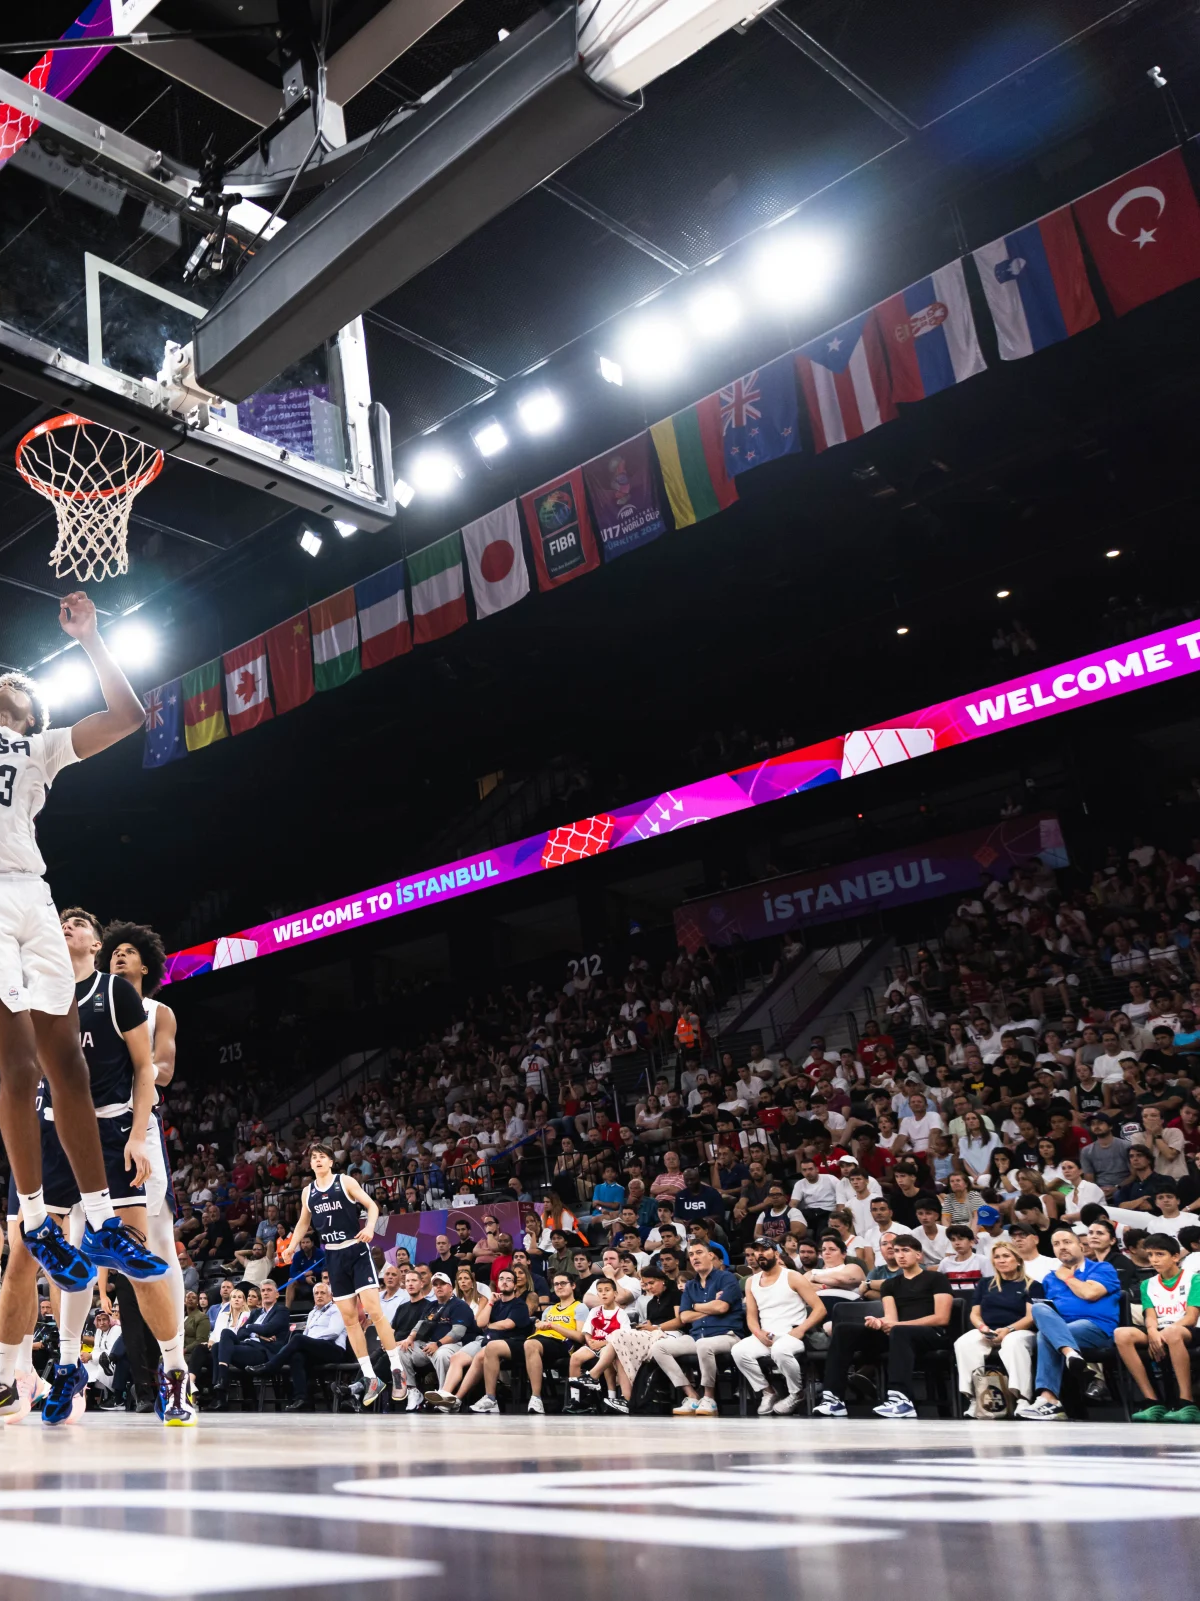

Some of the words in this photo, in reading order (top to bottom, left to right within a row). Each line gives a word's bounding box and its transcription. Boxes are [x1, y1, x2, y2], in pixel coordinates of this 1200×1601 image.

[620, 508, 634, 519] FIBA
[621, 519, 645, 535] WORLD
[645, 510, 660, 522] CUP
[549, 531, 577, 556] FIBA
[965, 643, 1174, 726] WELCOME
[272, 901, 365, 943] WELCOME
[366, 892, 393, 914] TO
[395, 859, 500, 905] İSTANBUL
[763, 858, 946, 923] İSTANBUL
[567, 954, 603, 978] 212
[219, 1042, 243, 1064] 213
[313, 1200, 343, 1215] SRBIJA
[684, 1201, 706, 1210] USA
[326, 1215, 333, 1227] 7
[321, 1230, 347, 1243] mts
